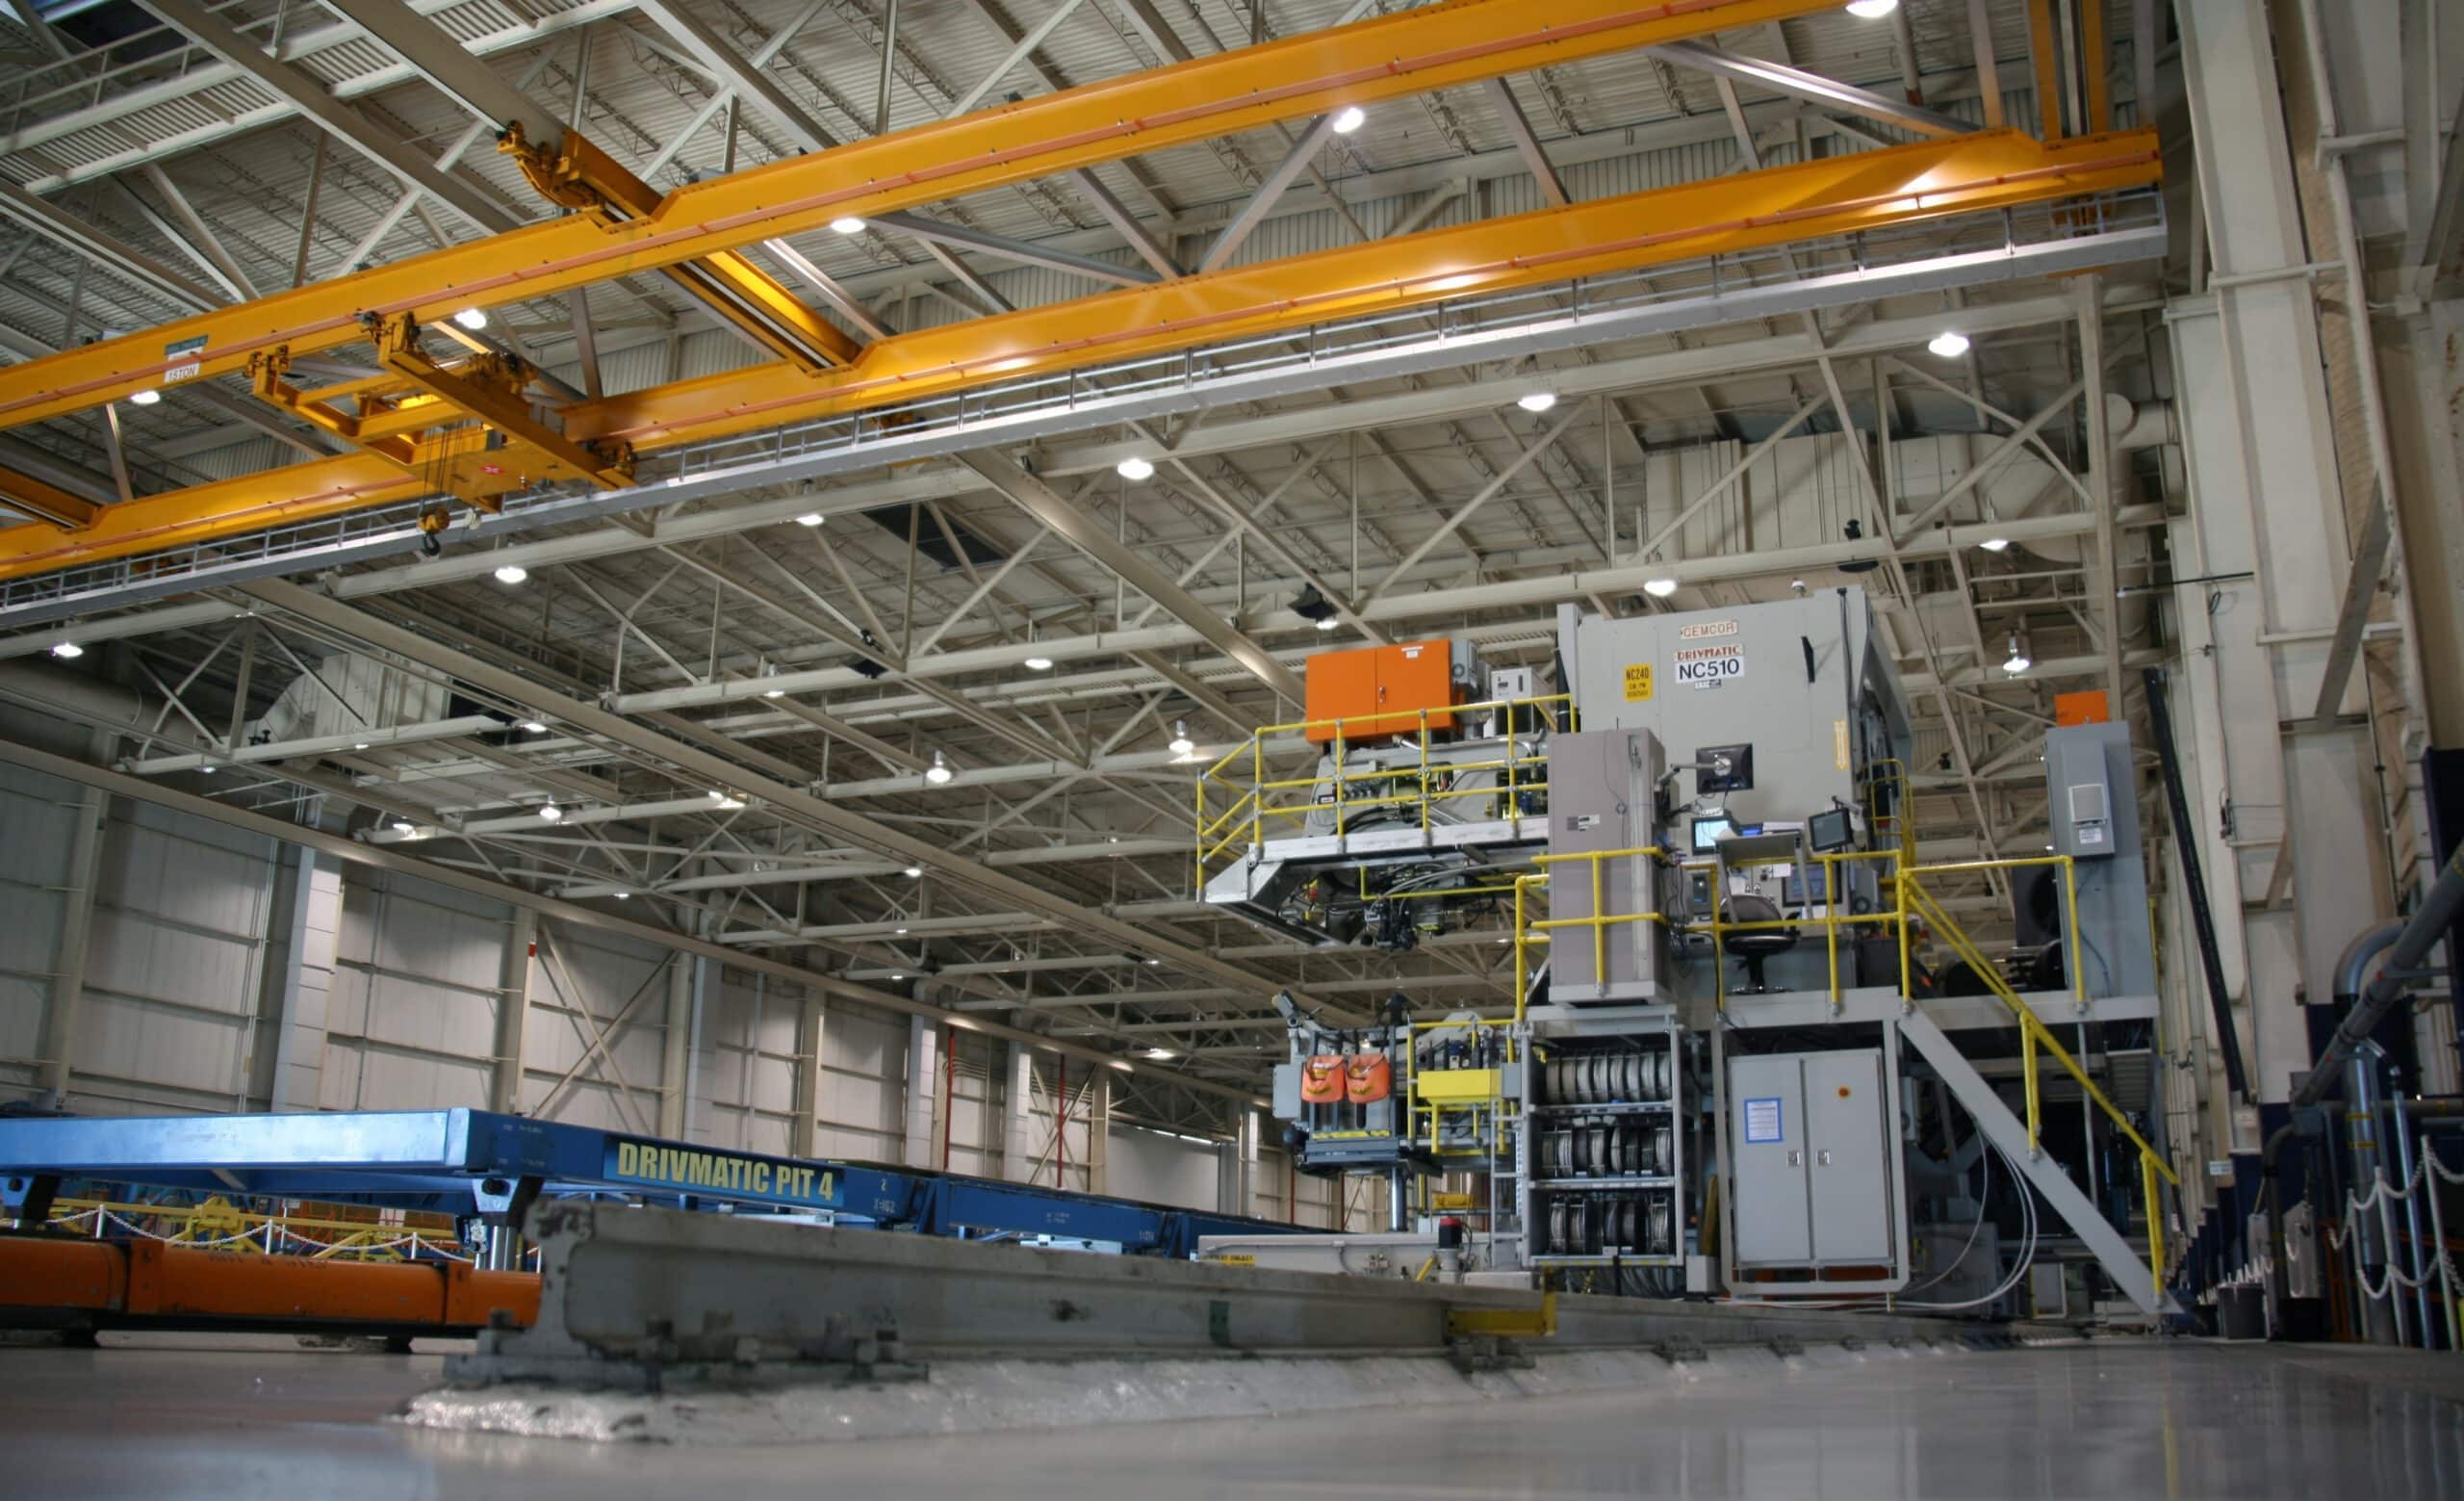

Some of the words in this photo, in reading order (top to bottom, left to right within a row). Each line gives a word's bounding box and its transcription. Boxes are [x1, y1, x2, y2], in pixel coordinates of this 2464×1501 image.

[1683, 622, 1735, 637] GEMCOR
[1679, 659, 1739, 680] NC510
[617, 1142, 770, 1194] DRIVMATIC
[776, 1165, 814, 1200] PIT
[819, 1172, 834, 1202] 4
